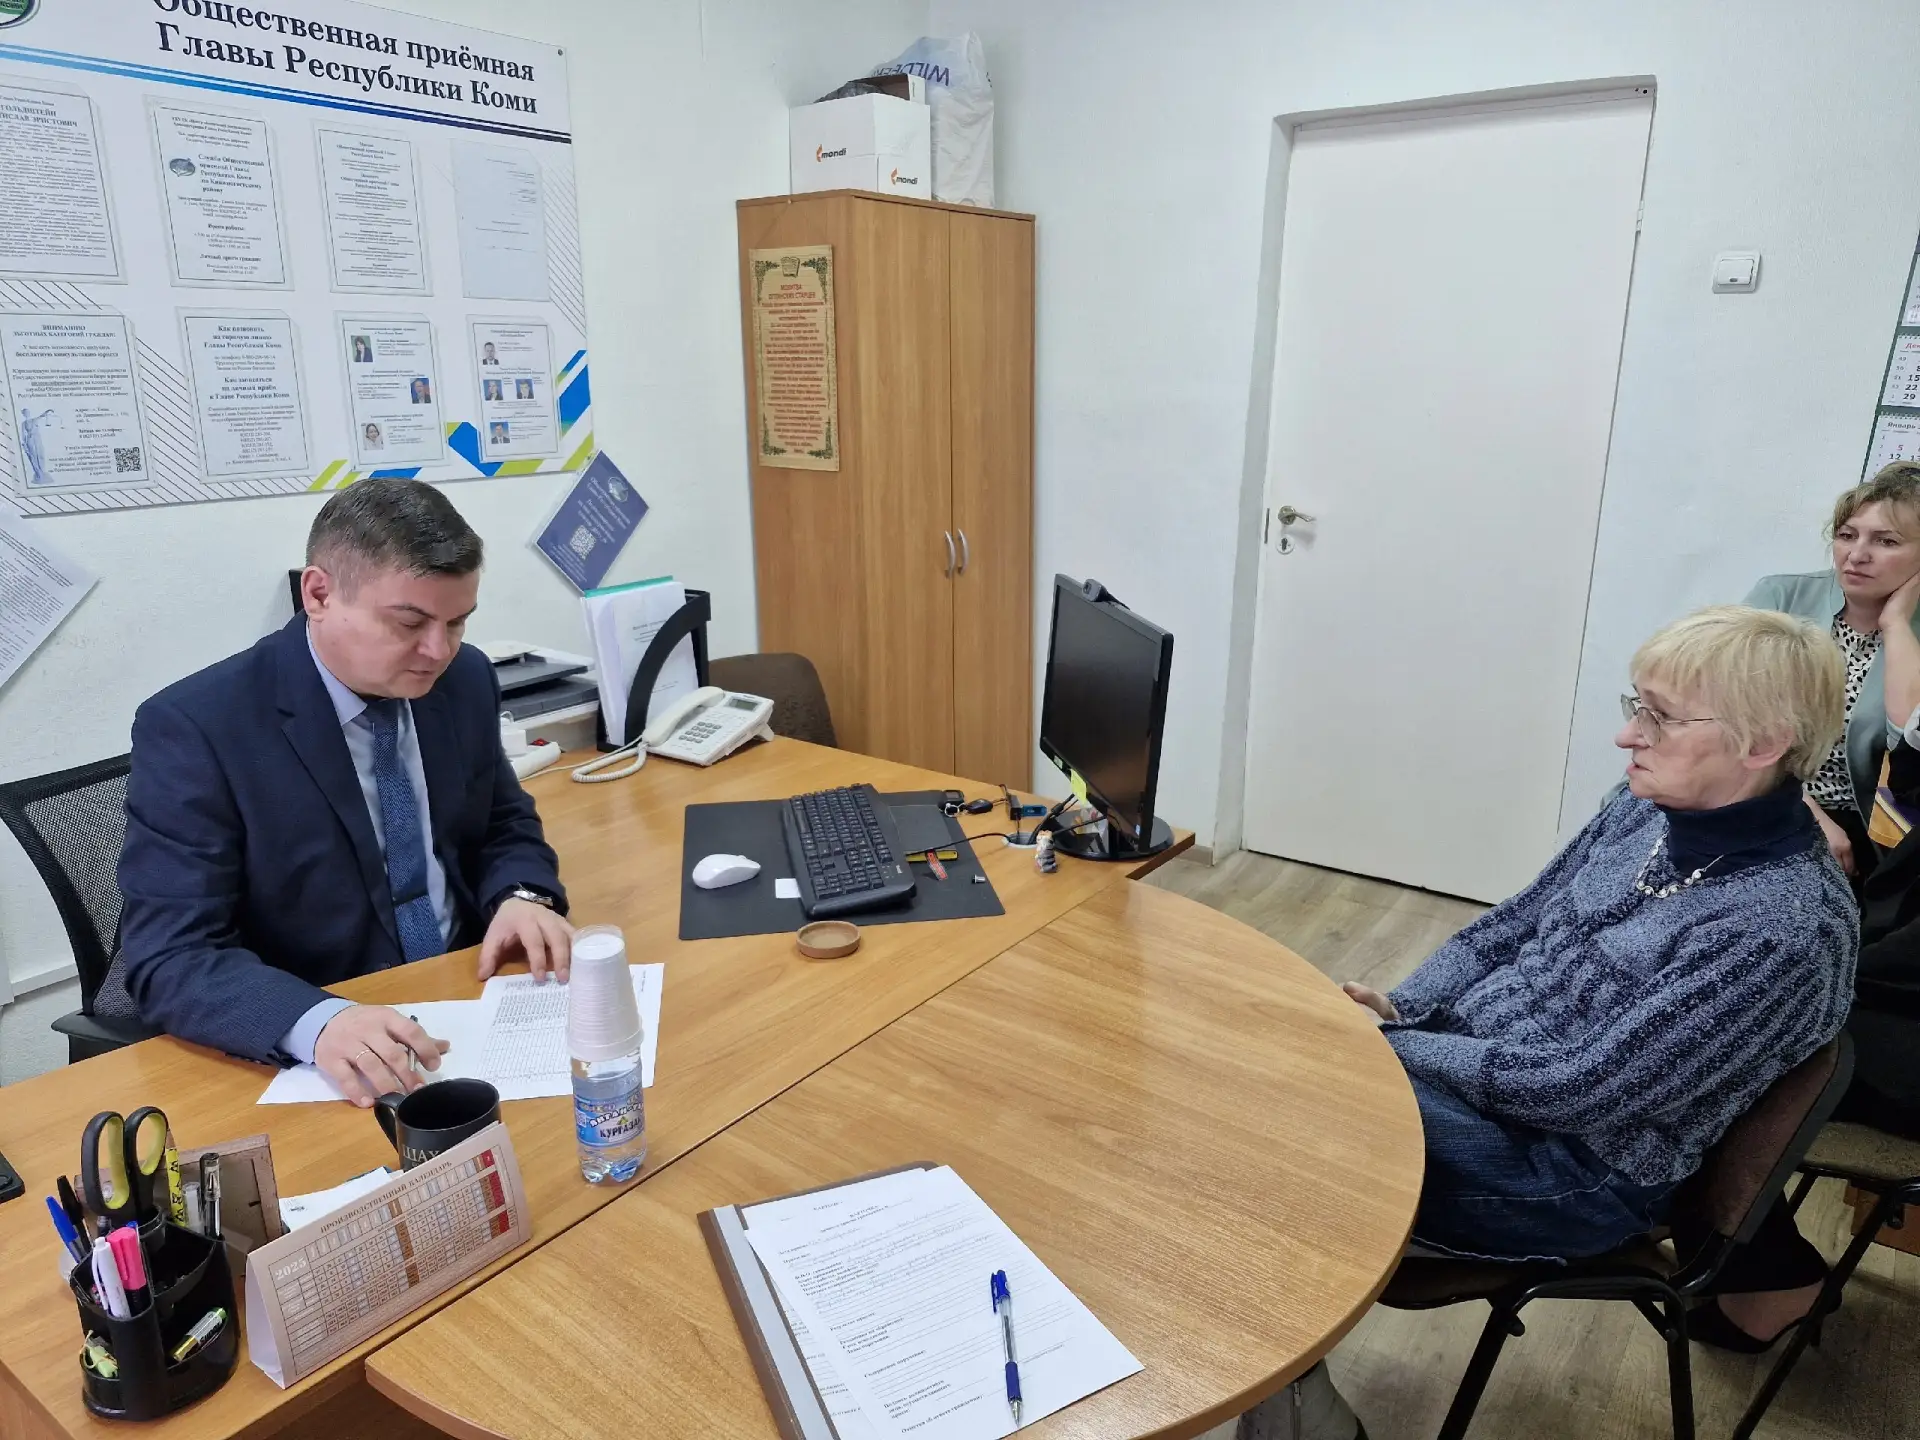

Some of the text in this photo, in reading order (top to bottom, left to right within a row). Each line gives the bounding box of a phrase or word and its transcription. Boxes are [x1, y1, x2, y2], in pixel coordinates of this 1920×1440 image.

[155, 22, 537, 113] Главы Республики Коми
[406, 41, 535, 81] приёмная
[821, 148, 847, 158] mondi
[895, 176, 918, 185] mondi
[409, 1161, 452, 1186] КАЛЕНДАРЬ
[274, 1257, 307, 1280] 2025
